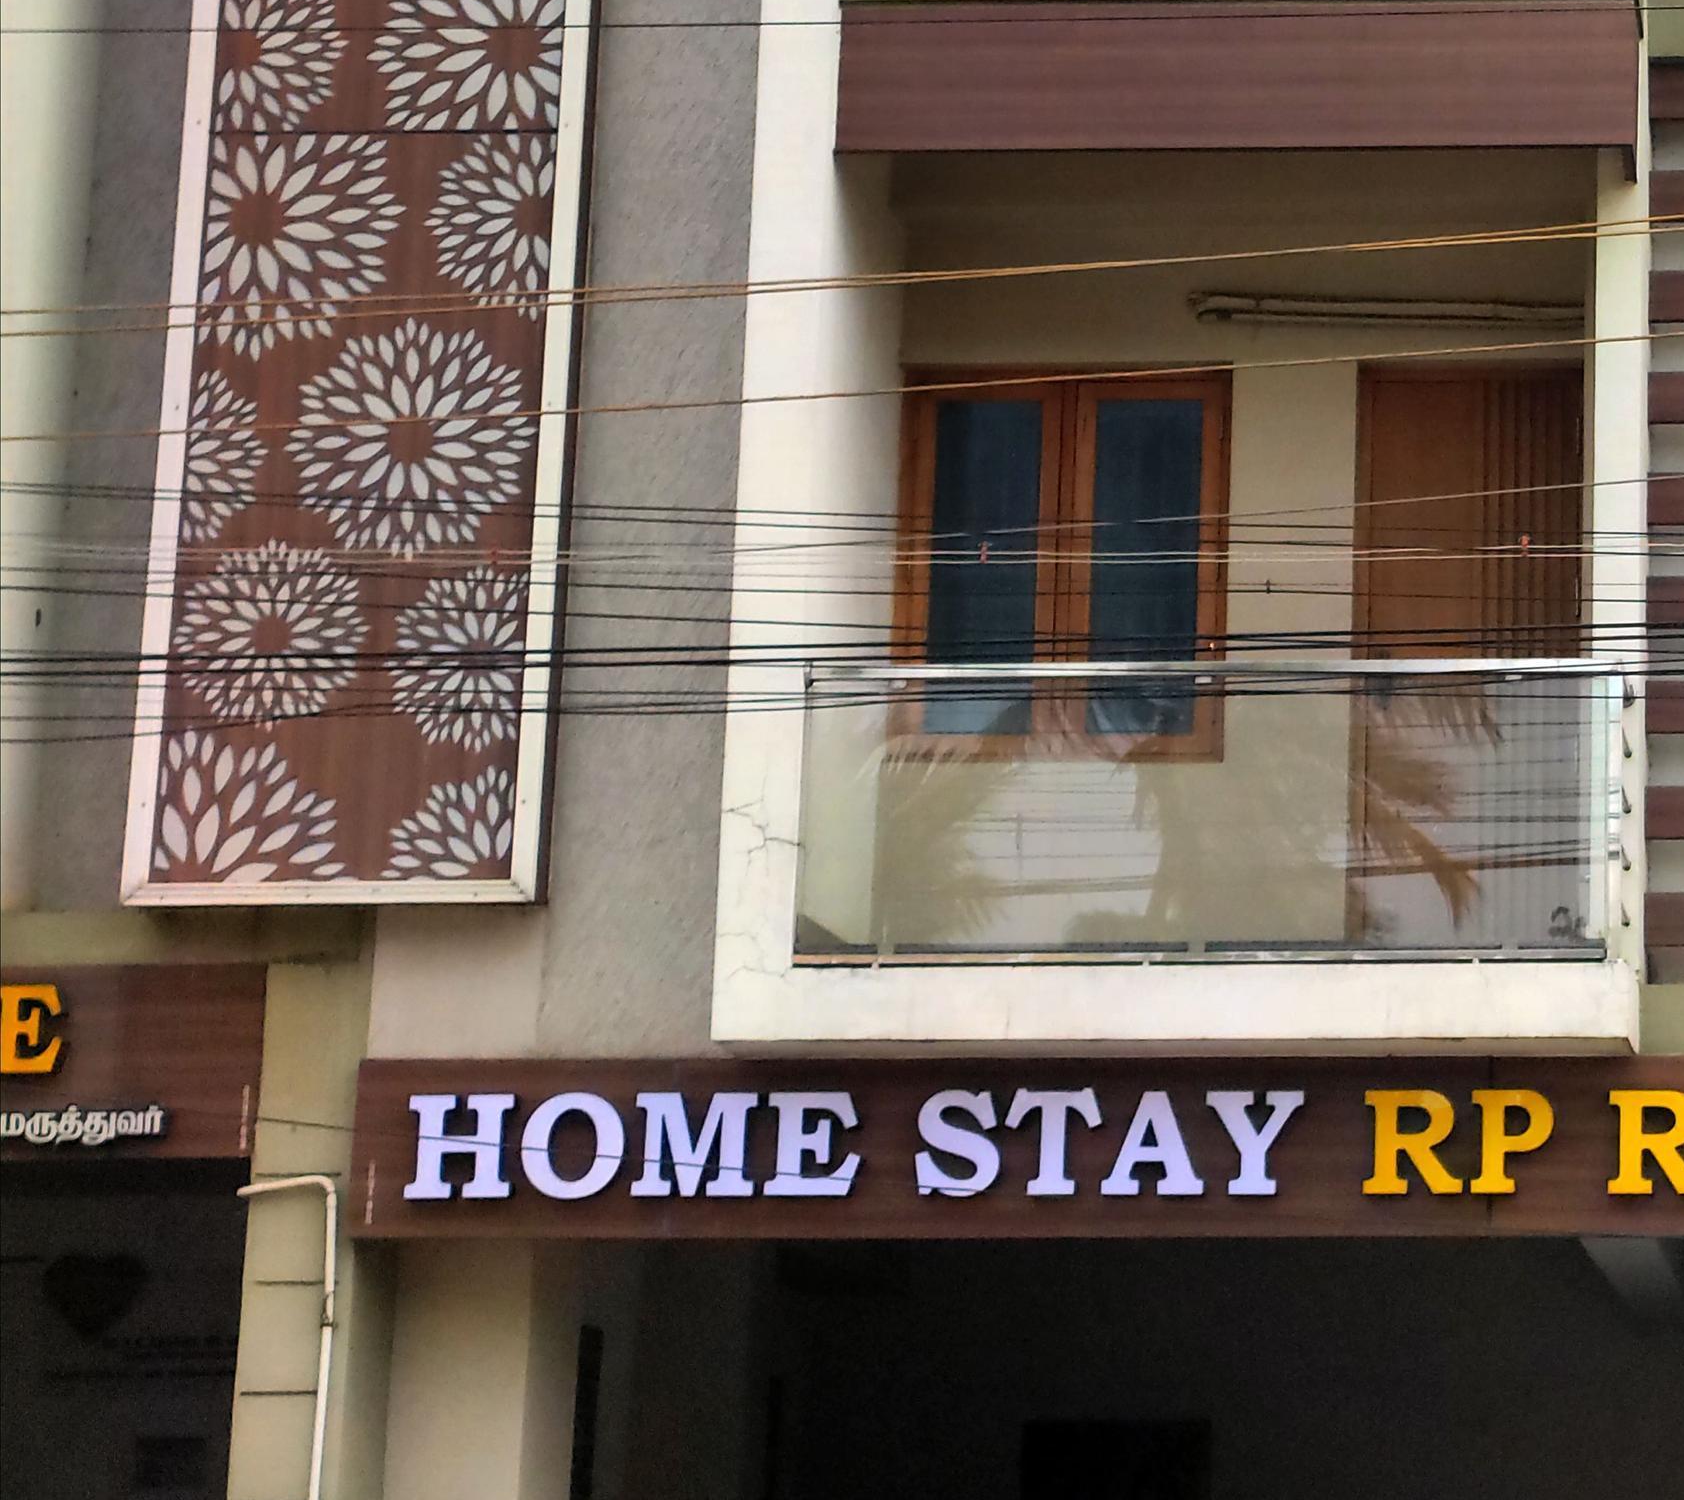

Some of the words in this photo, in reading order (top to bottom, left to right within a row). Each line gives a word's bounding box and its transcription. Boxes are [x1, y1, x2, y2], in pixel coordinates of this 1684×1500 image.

[403, 1092, 861, 1199] HOME
[915, 1087, 1304, 1197] STAY
[1363, 1090, 1554, 1194] RP
